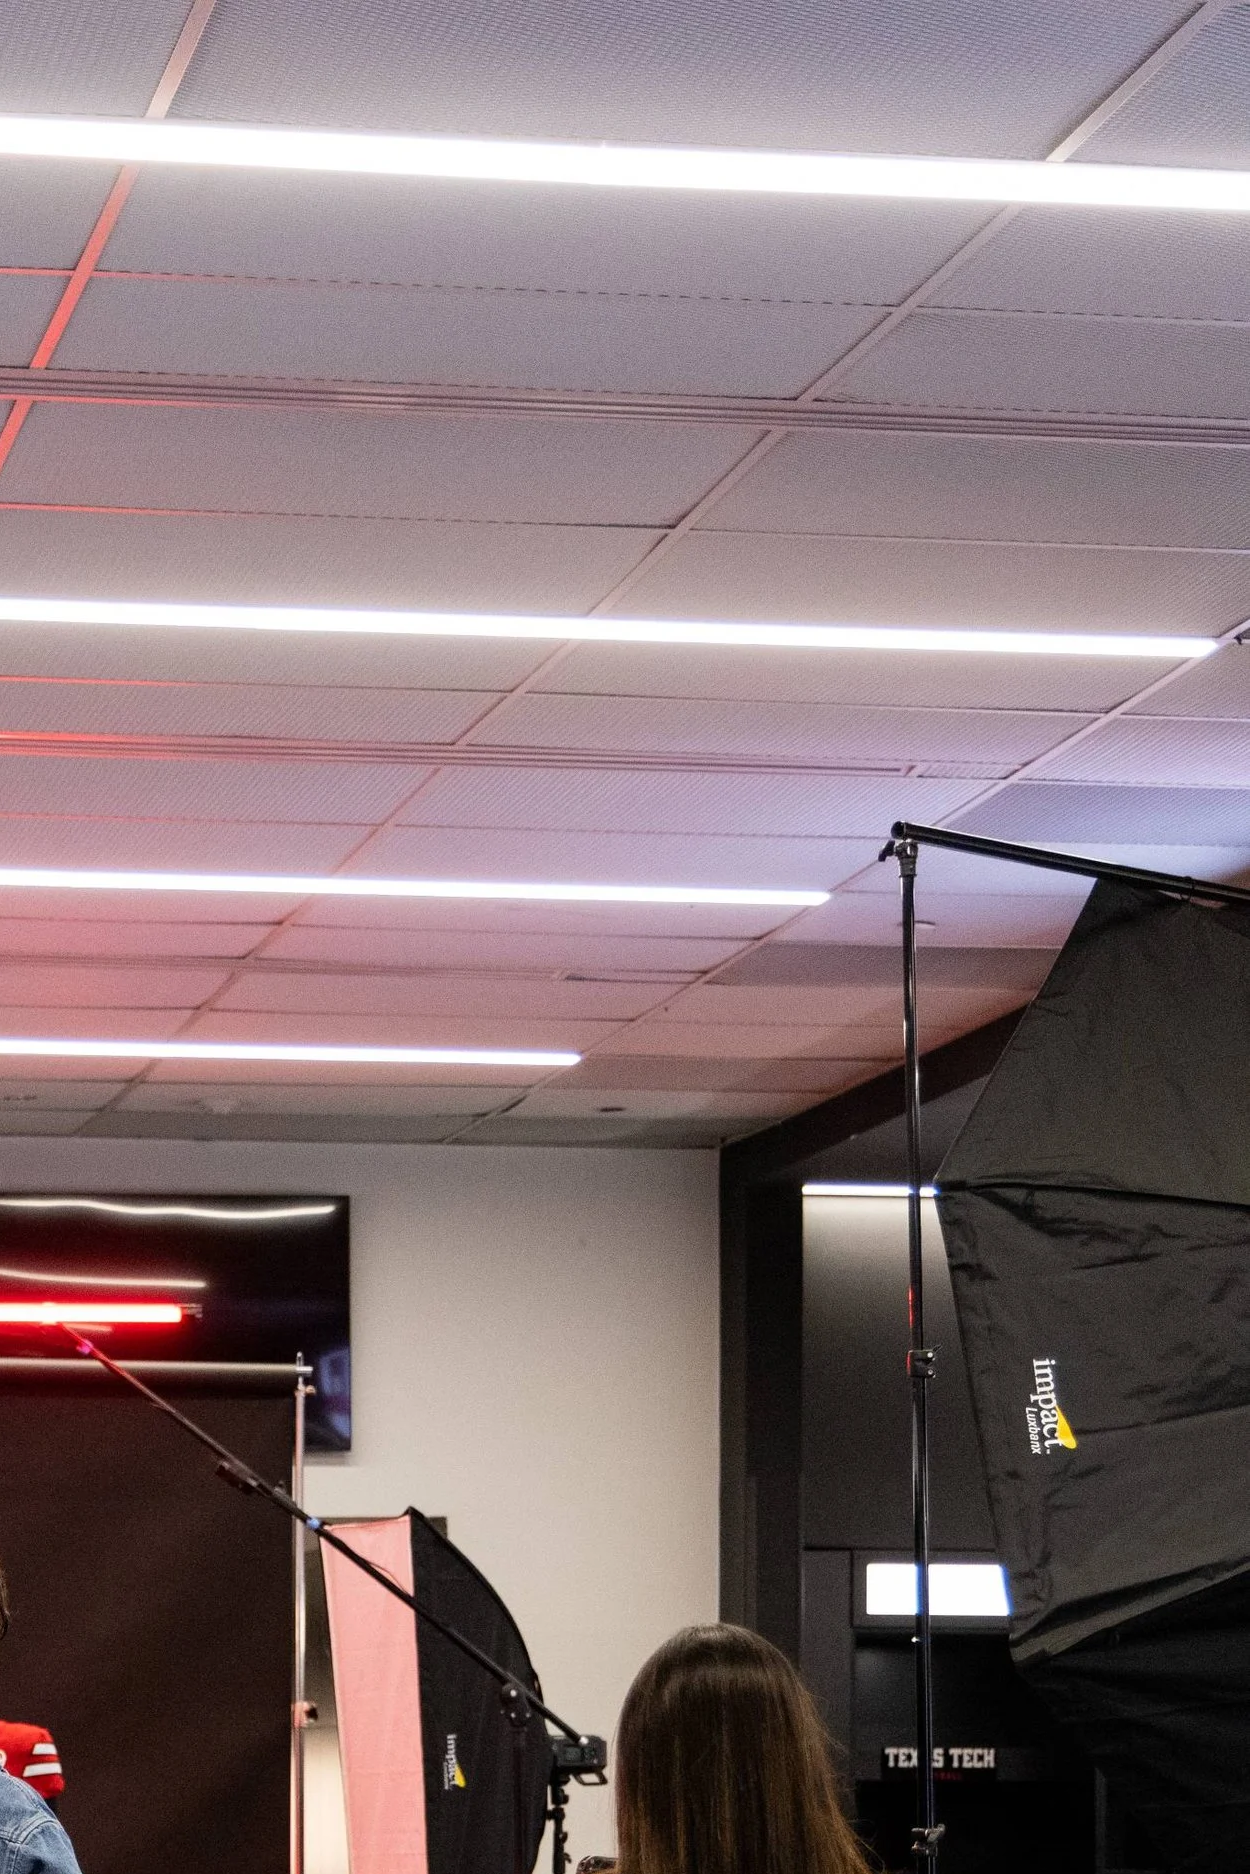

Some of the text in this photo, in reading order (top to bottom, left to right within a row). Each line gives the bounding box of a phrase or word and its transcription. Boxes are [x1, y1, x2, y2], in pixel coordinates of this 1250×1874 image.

[1026, 1407, 1041, 1455] Luxbanx
[884, 1747, 995, 1768] TEXS TECH
